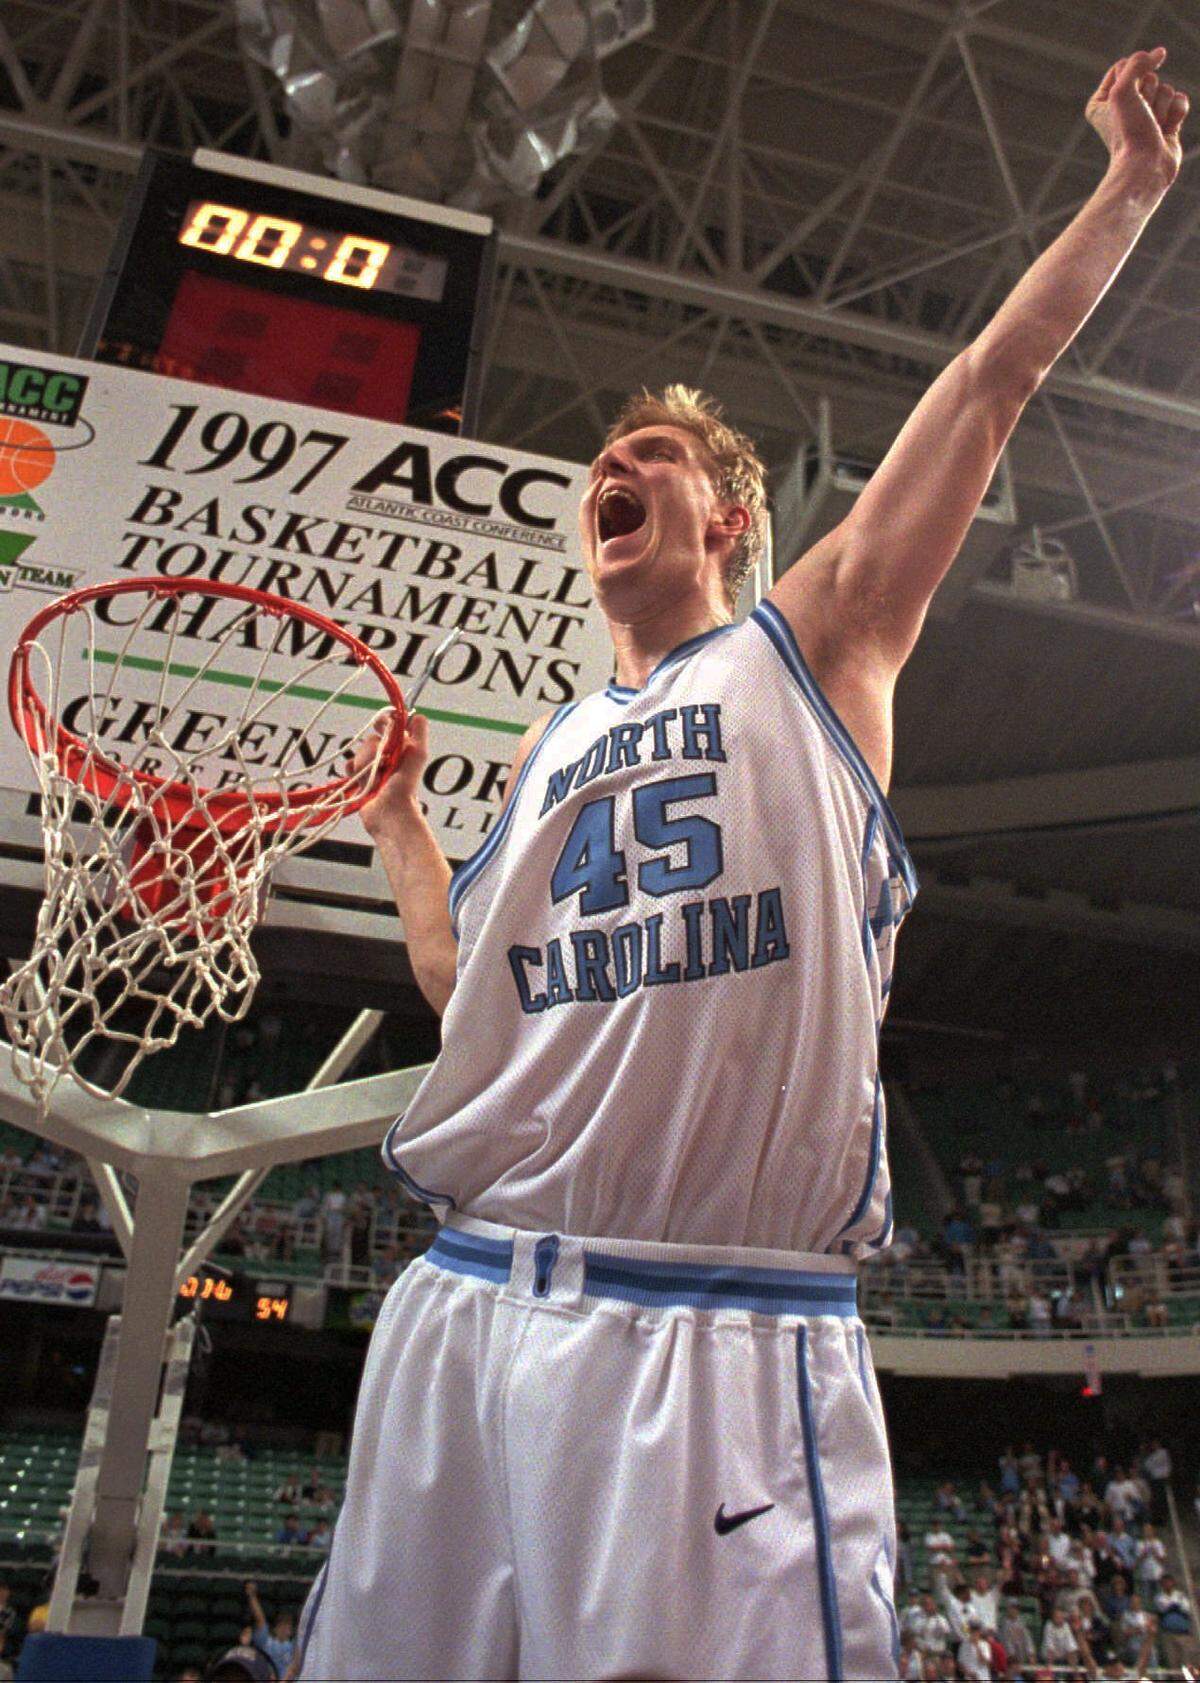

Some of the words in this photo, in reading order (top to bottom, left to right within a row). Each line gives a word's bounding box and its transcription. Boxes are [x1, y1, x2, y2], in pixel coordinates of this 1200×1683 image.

[137, 404, 349, 496] 1997
[350, 440, 573, 531] ACC
[348, 496, 420, 519] ATLANTIC
[421, 511, 471, 530] COAST
[471, 519, 568, 549] CONFERENCE
[20, 567, 76, 589] TEAM
[114, 531, 586, 651] TOURNAMENT
[125, 484, 594, 609] BASKETBALL
[94, 590, 582, 705] CHAMPIONS
[538, 703, 728, 821] NORTH
[550, 772, 724, 918] 45
[507, 886, 791, 1015] CAROLINA
